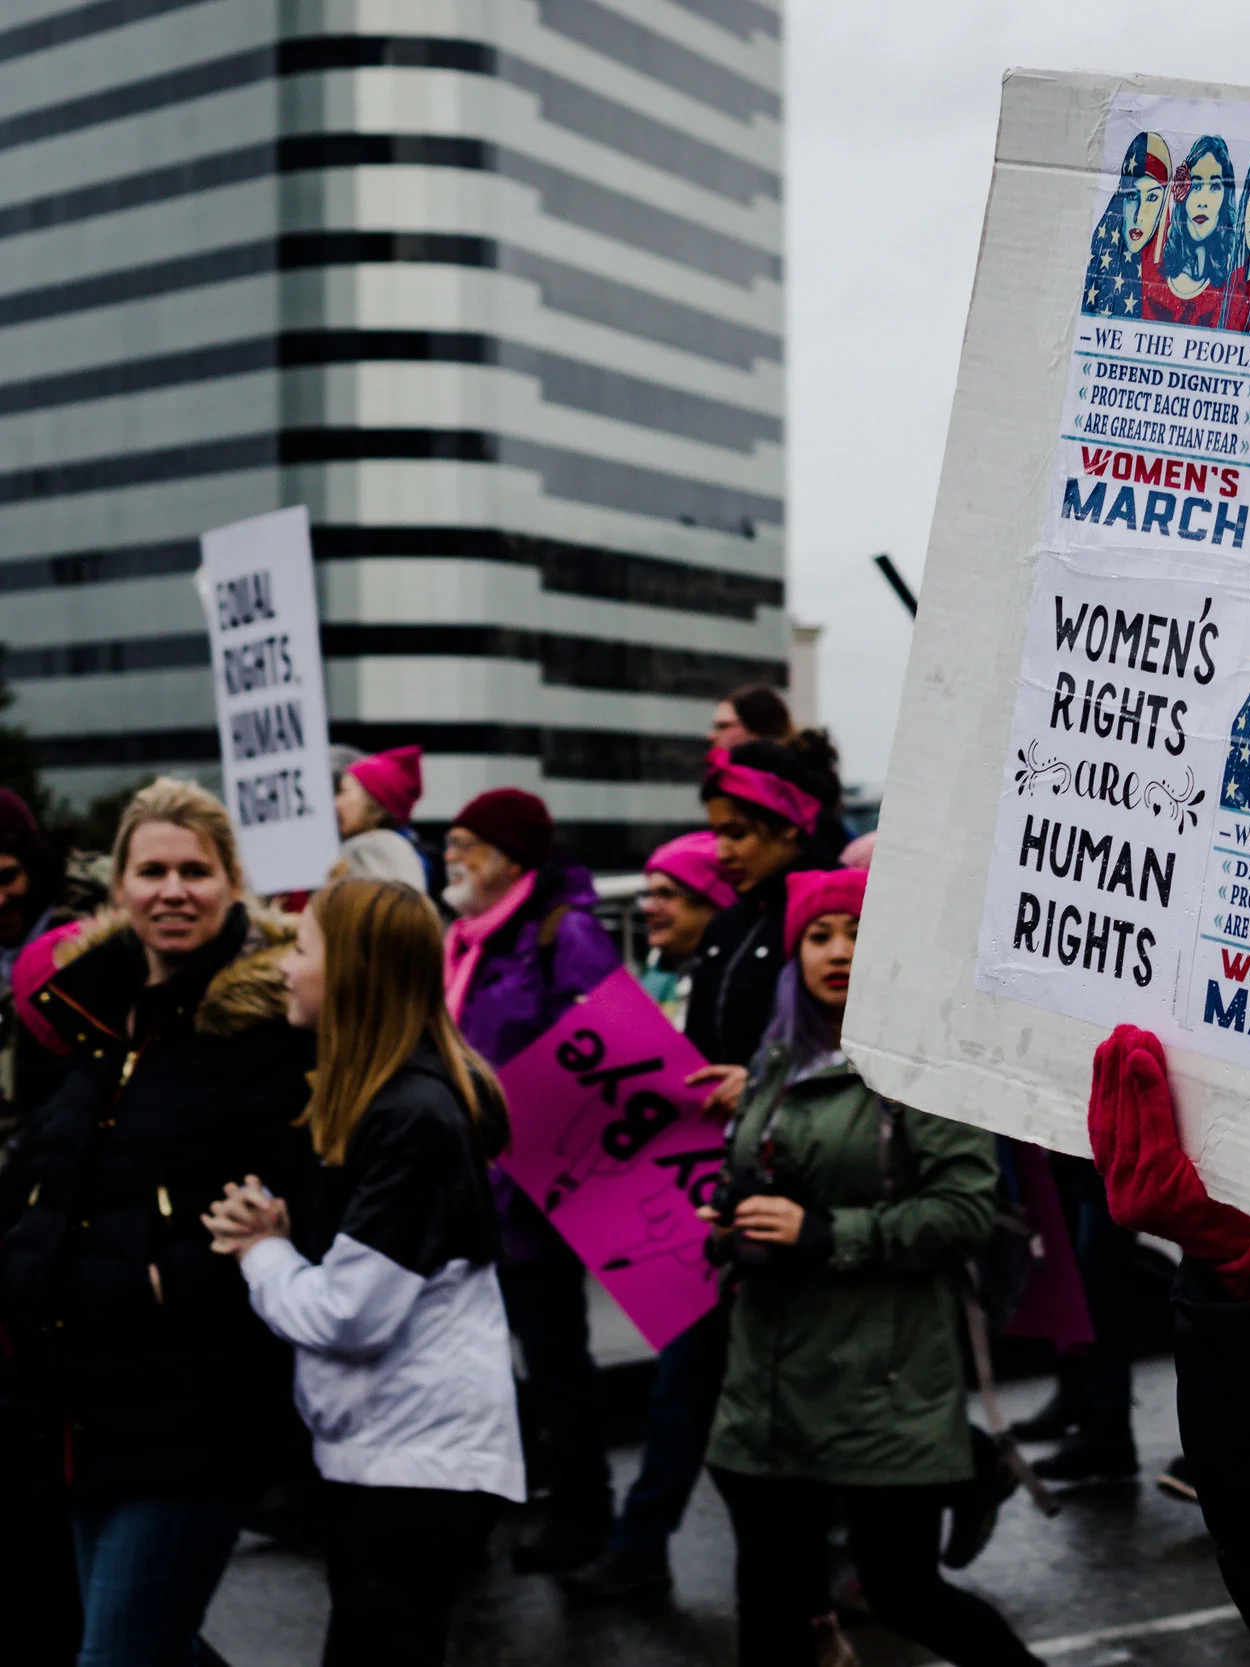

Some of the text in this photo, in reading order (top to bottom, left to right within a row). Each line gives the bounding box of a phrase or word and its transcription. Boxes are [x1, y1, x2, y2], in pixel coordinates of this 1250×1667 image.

[1135, 333, 1173, 357] THE
[1090, 386, 1239, 425] PROTECT EACH OTHER
[1096, 363, 1244, 397] DEFEND DIGNITY
[1084, 414, 1237, 454] ARE GREATER THAN FEAR
[1082, 446, 1239, 497] WOMEN'S
[1061, 477, 1249, 548] MARCH
[217, 569, 275, 631] EQUAL
[1055, 596, 1219, 685] WOMEN'S
[231, 700, 304, 761] HUMAN
[1050, 672, 1188, 756] RIGHTS
[1019, 814, 1175, 908] HUMAN
[1014, 892, 1157, 987] RIGHTS
[1224, 914, 1248, 938] ARE
[555, 1028, 727, 1210] oy Bye
